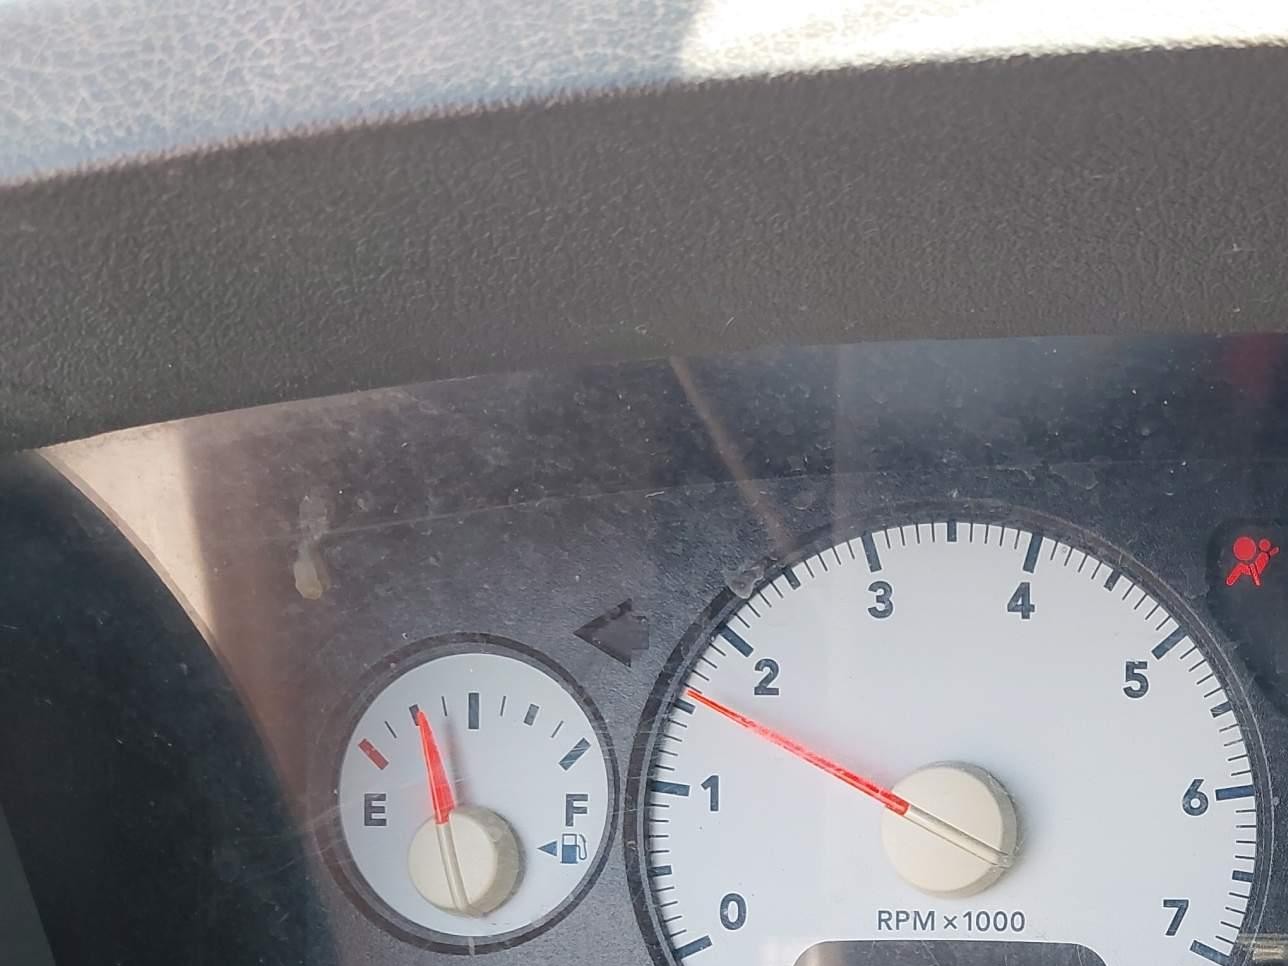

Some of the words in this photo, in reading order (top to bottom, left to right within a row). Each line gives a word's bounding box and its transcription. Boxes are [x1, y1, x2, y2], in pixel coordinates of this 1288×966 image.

[868, 582, 893, 618] 3
[1007, 583, 1035, 619] 4
[753, 659, 780, 695] 2
[1123, 662, 1149, 698] 5
[364, 794, 387, 827] E
[565, 794, 588, 827] F
[700, 775, 720, 811] 1
[1182, 779, 1209, 816] 6
[720, 894, 747, 930] 0
[877, 911, 936, 931] RPM
[1162, 899, 1189, 935] 7
